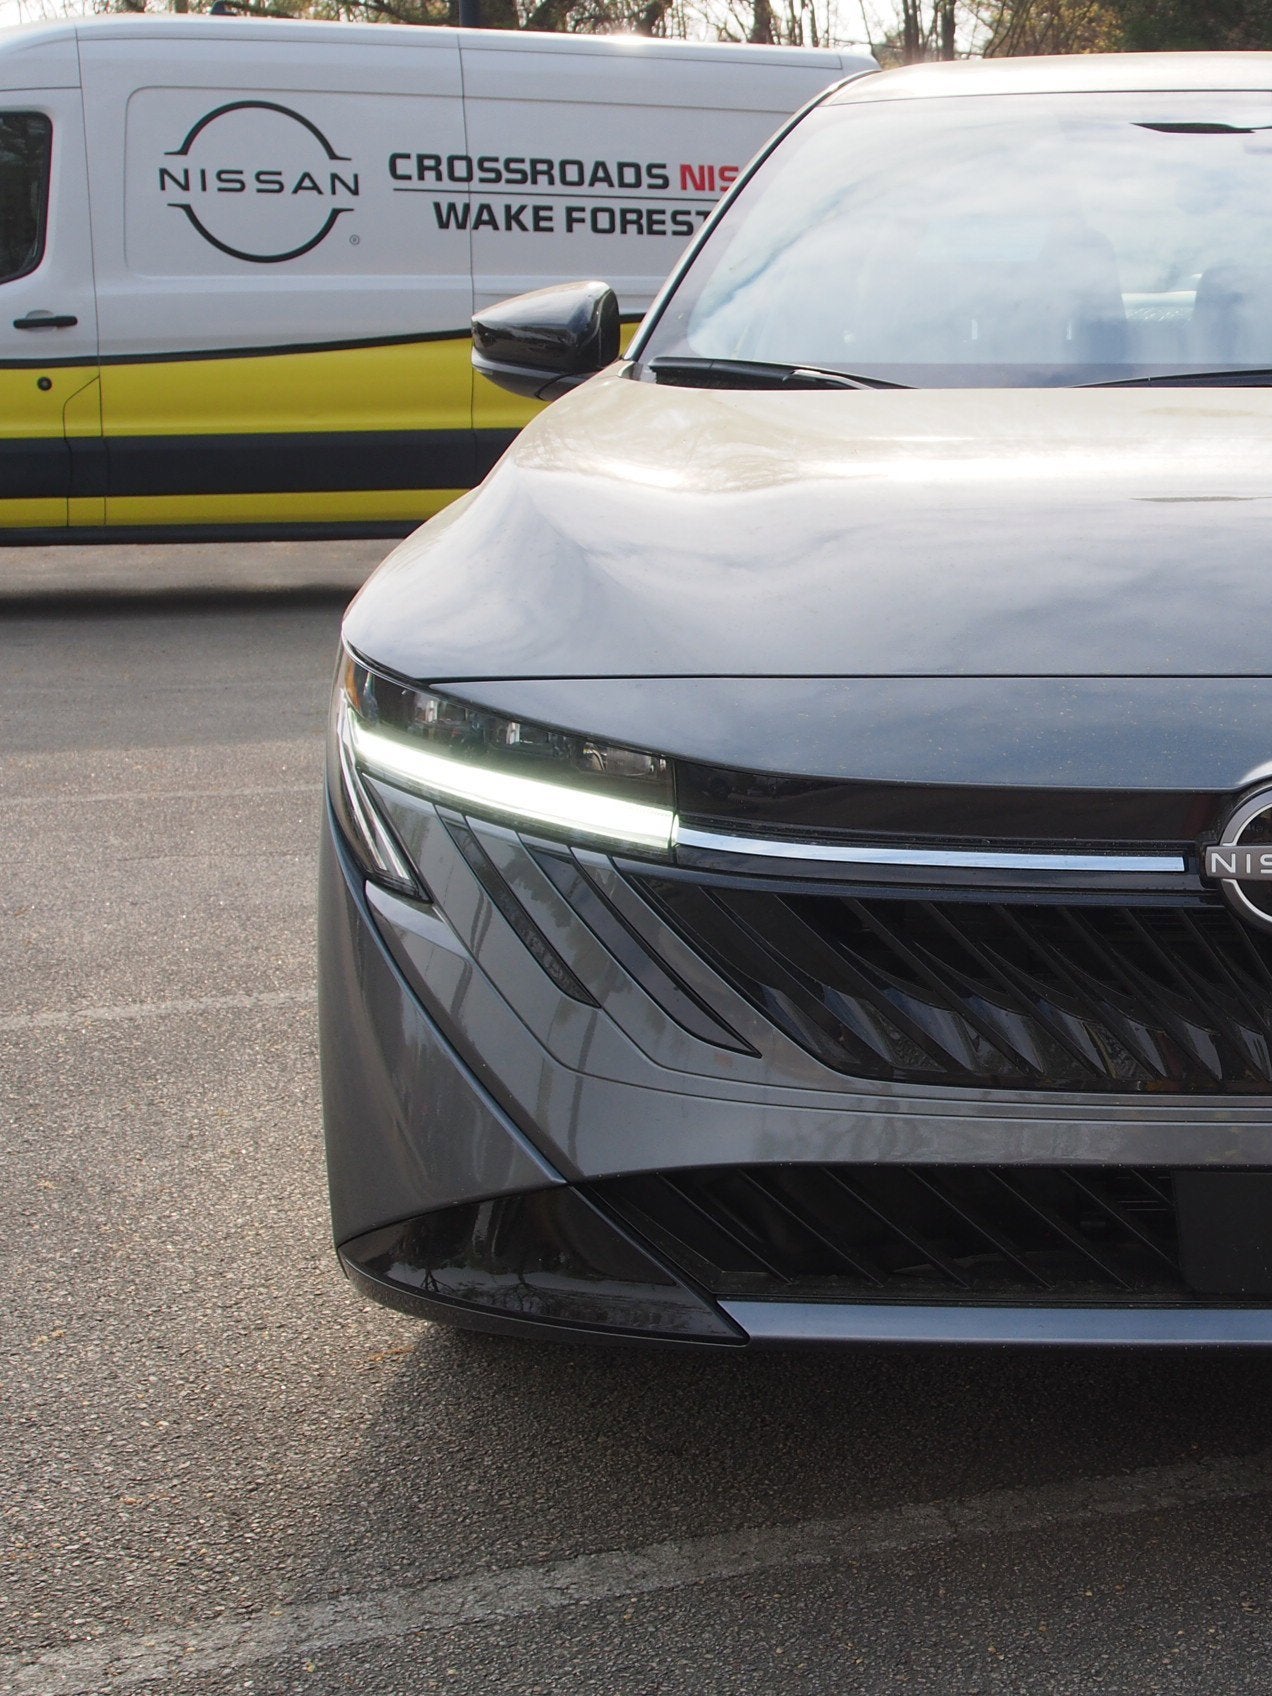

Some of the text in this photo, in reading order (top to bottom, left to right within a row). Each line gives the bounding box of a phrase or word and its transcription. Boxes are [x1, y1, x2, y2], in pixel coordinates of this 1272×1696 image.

[158, 167, 360, 196] NISSAN
[388, 152, 670, 190] CROSSROADS
[432, 201, 554, 232] WAKE
